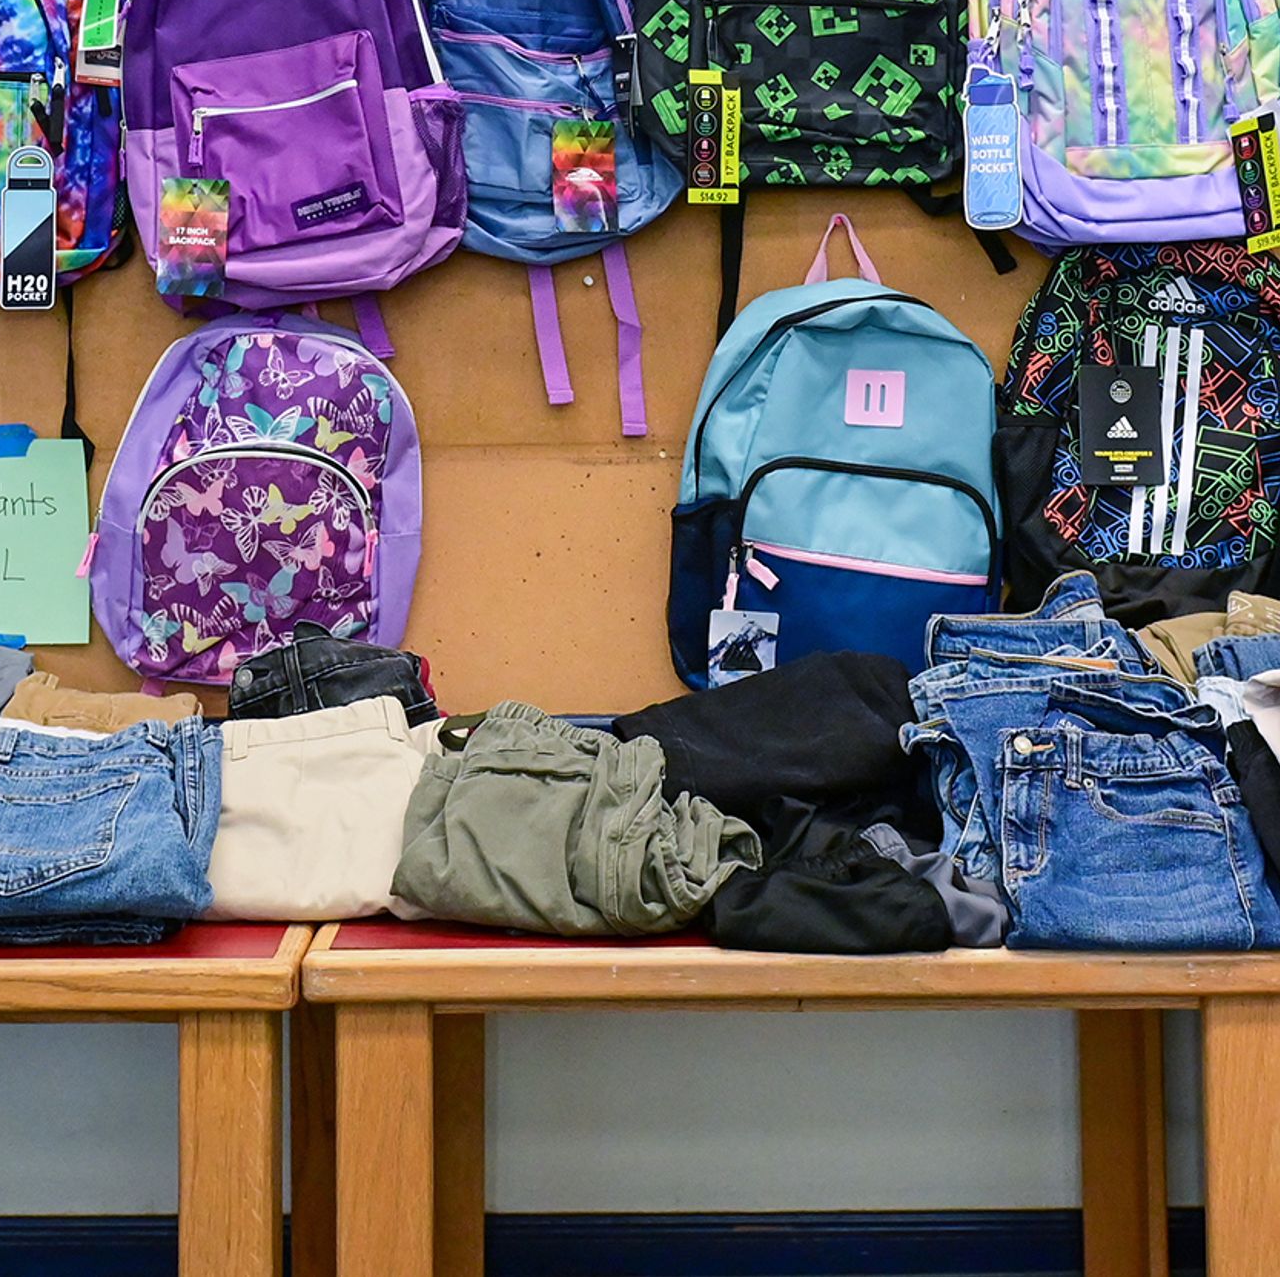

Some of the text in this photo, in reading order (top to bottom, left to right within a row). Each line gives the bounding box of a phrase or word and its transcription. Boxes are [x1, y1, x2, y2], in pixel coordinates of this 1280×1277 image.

[724, 94, 736, 157] BACKPACK
[971, 134, 1010, 145] WATER
[972, 148, 1013, 160] BOTTLE
[1263, 132, 1280, 189] BACKPACK
[971, 162, 1015, 174] POCKET
[699, 191, 729, 203] $14.92
[176, 226, 209, 236] 17 INCH
[168, 235, 216, 247] BACKPACK
[6, 292, 48, 302] POCKET
[1148, 298, 1206, 315] adidas
[2, 548, 26, 582] L
